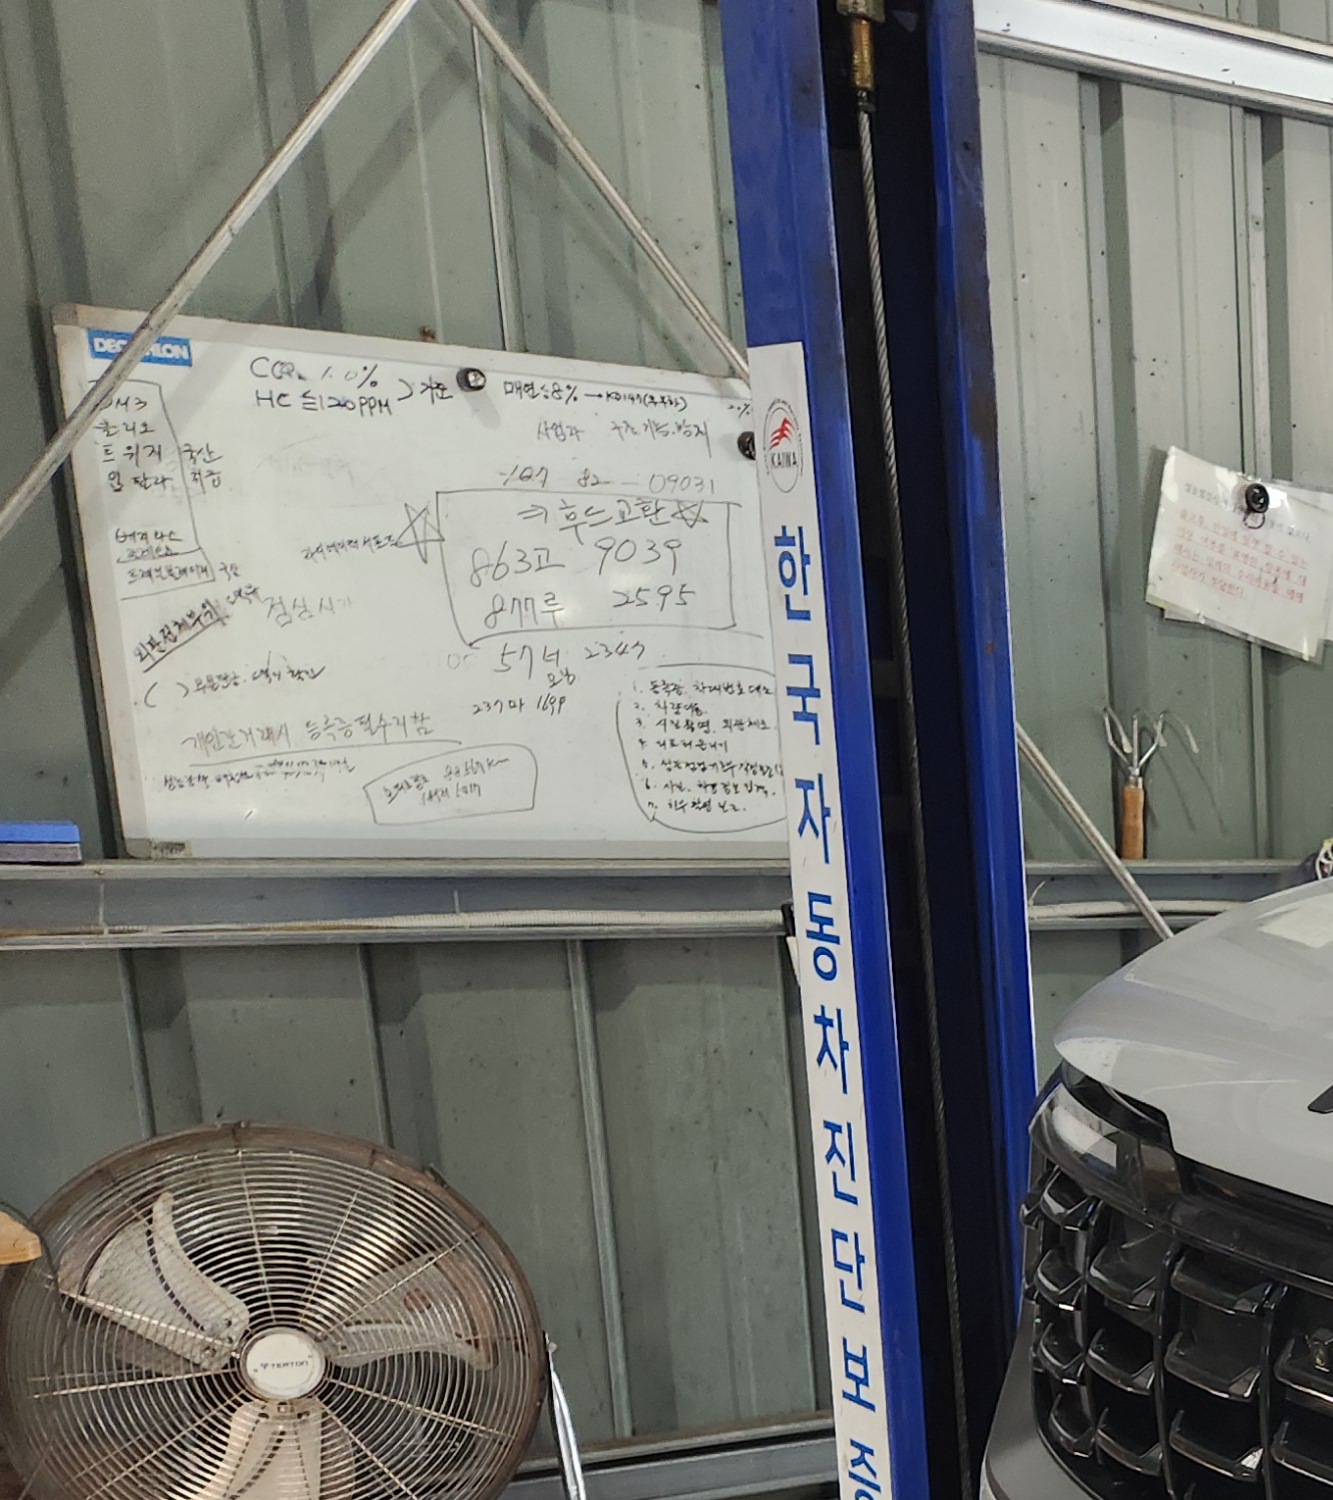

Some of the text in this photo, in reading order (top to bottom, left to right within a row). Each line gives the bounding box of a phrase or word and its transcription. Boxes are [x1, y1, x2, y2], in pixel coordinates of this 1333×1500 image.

[93, 337, 190, 360] DECLON
[594, 536, 682, 576] 9039
[612, 583, 697, 612] 2595
[585, 641, 645, 661] 2347
